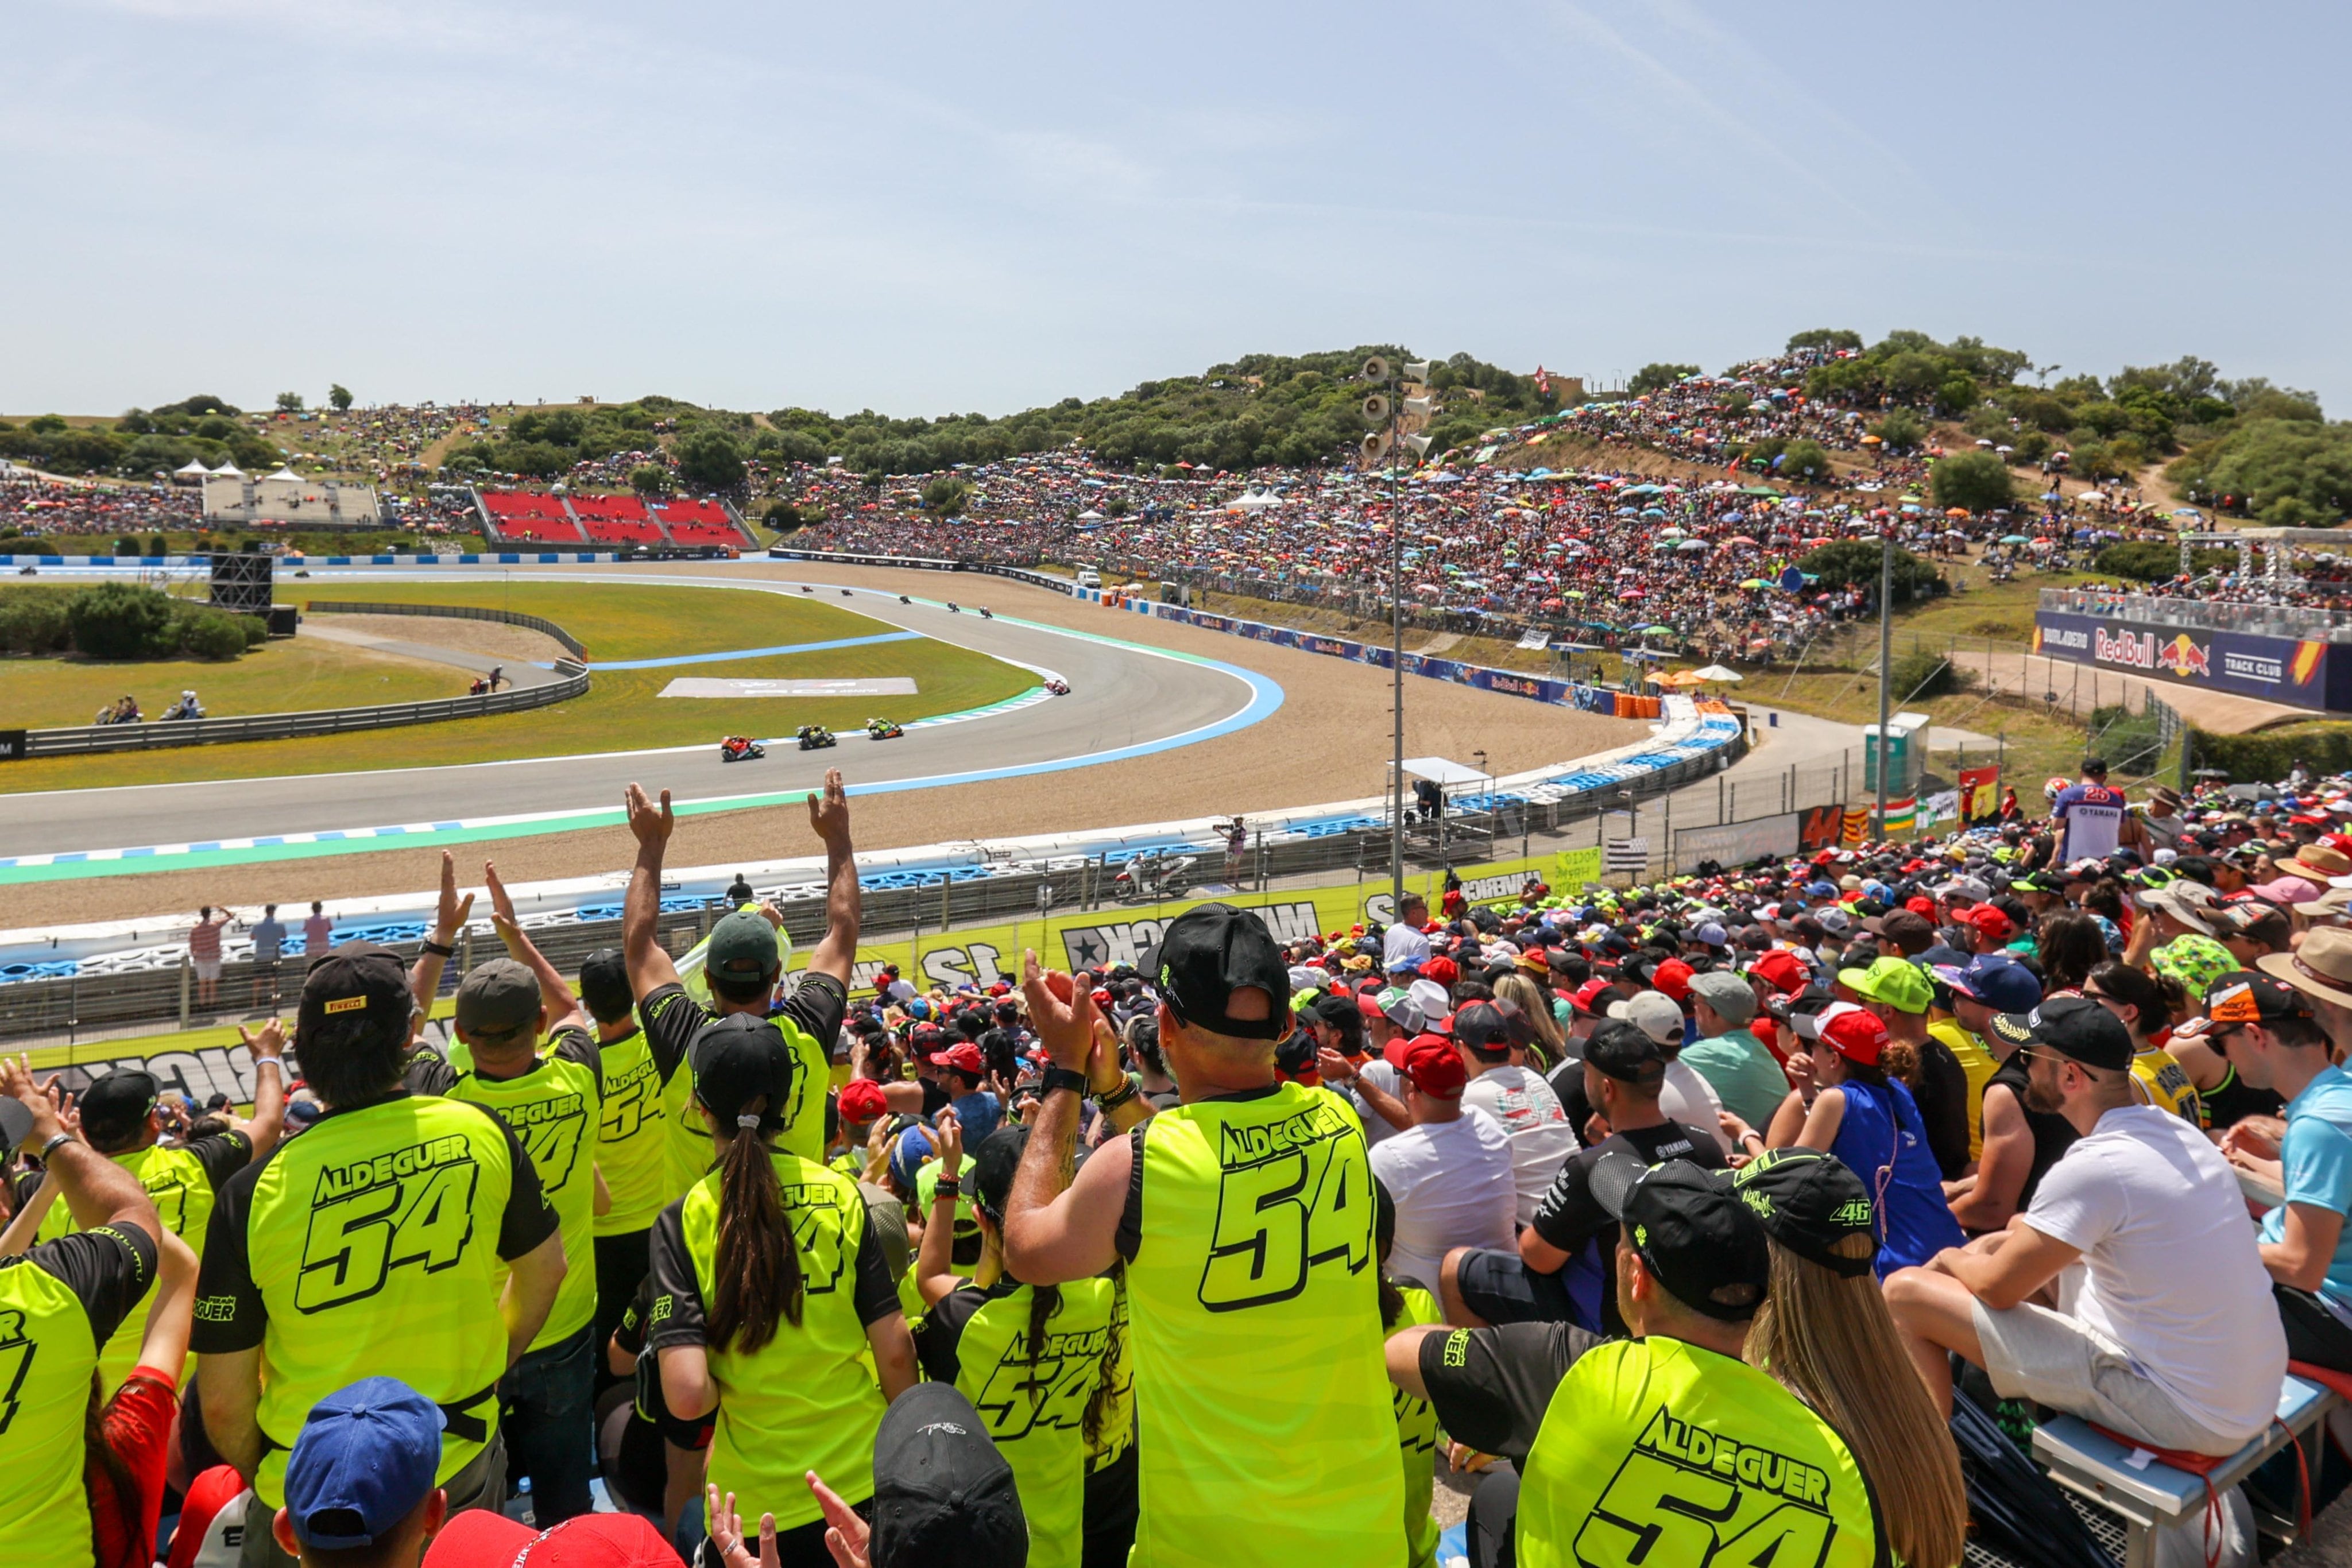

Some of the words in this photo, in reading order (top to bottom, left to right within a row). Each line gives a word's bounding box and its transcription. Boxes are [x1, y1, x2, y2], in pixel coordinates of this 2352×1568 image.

[2225, 658, 2254, 673] TRACK
[2256, 663, 2282, 677] CLUB
[2084, 786, 2110, 802] 25
[2090, 808, 2118, 818] YAMAHA
[1802, 806, 1843, 849] 44
[329, 1000, 361, 1012] PIRELLI
[1220, 1102, 1357, 1170] ALDEGUER
[311, 1134, 471, 1207] ALDEGUER
[1198, 1127, 1375, 1313] 54
[1836, 1199, 1871, 1225] 46
[295, 1160, 479, 1315] 54
[1633, 1402, 1830, 1513] ALDEGUER
